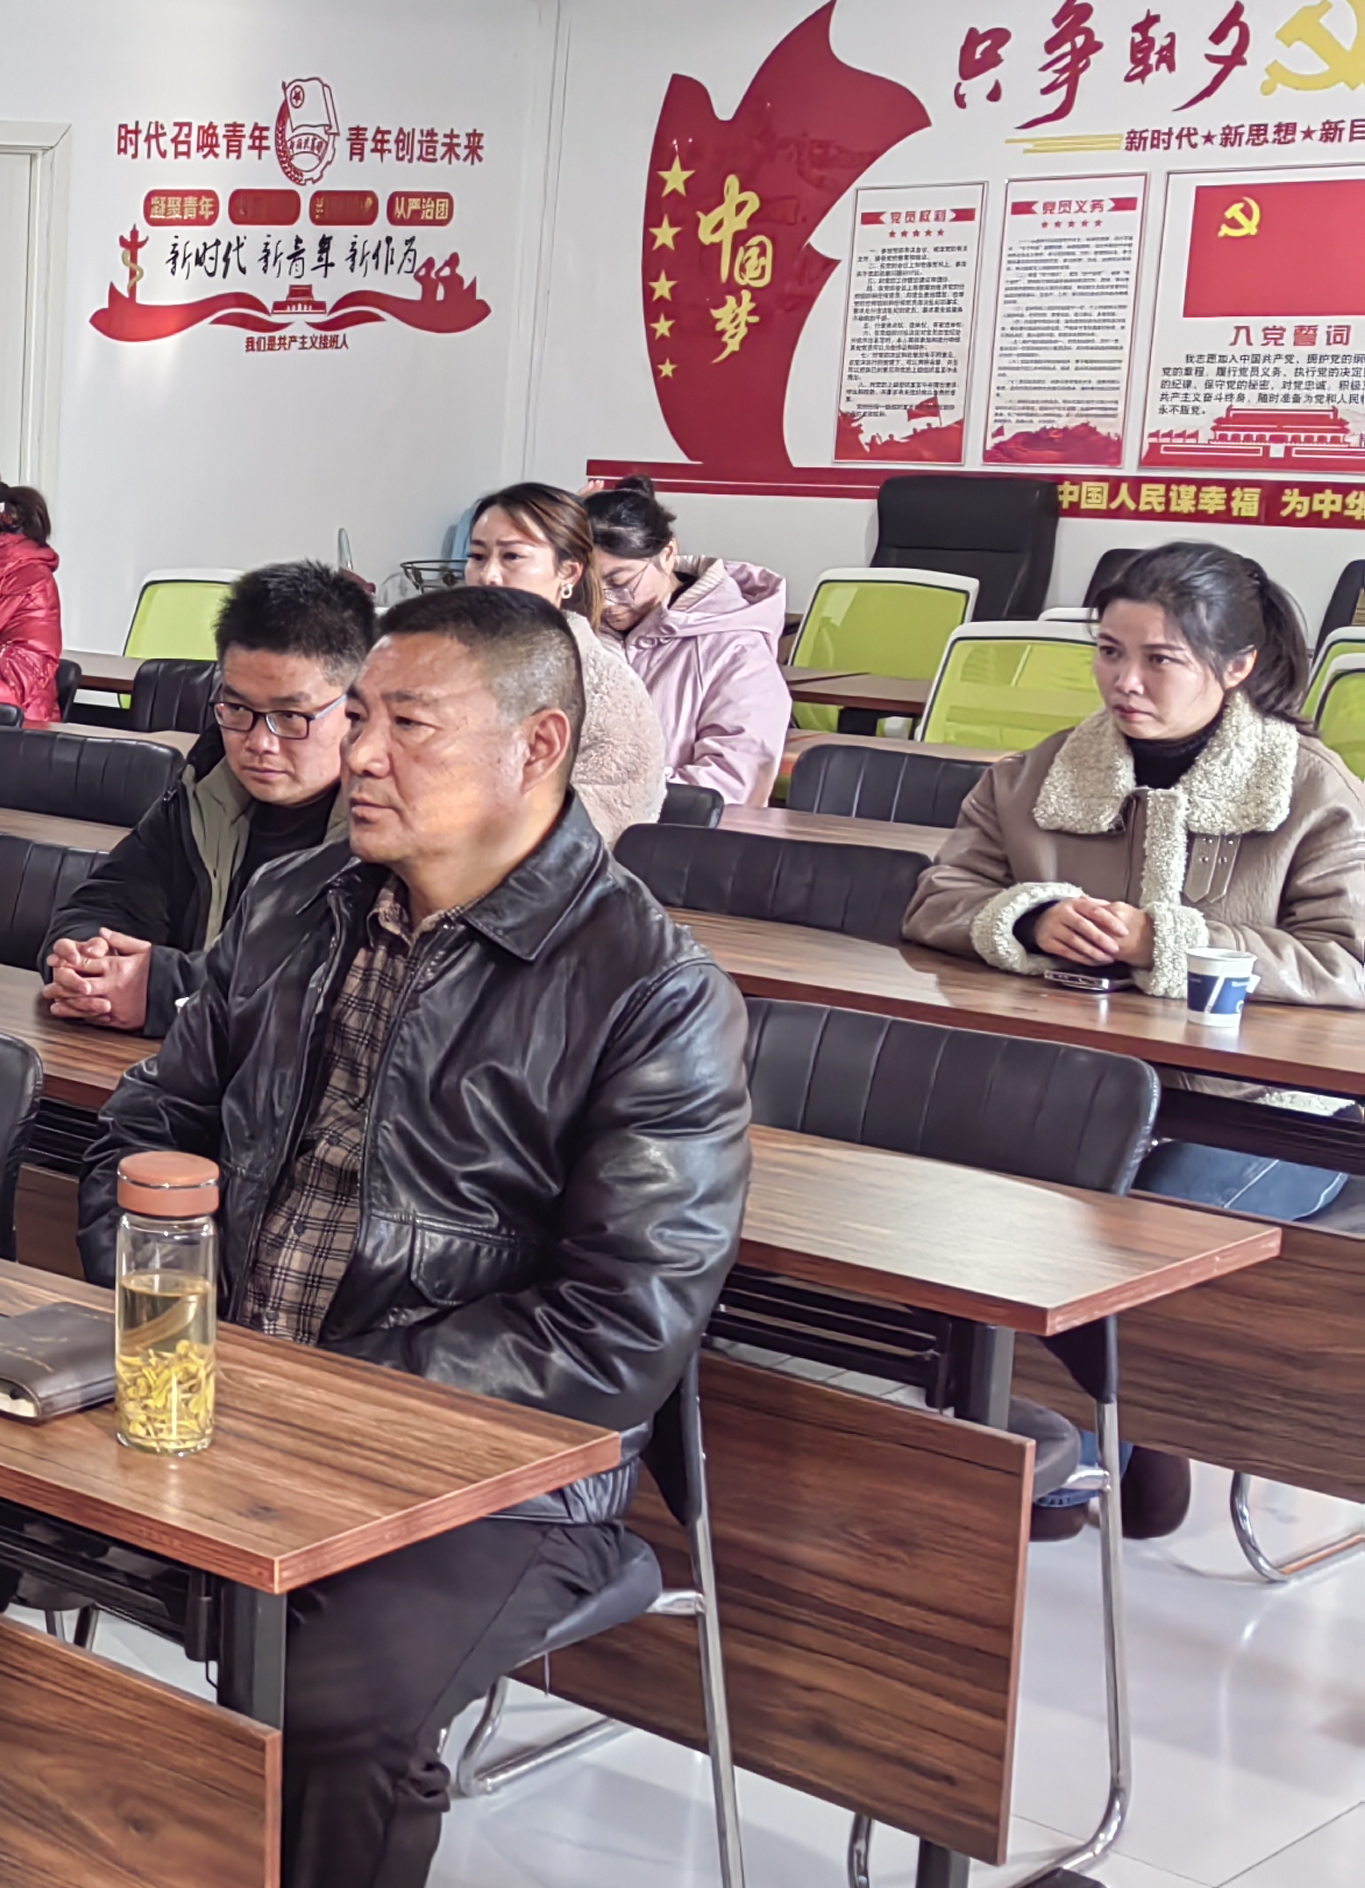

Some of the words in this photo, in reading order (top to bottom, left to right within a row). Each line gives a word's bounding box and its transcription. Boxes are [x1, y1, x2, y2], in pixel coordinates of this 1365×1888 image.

[954, 0, 1250, 130] 只争朝夕
[117, 121, 271, 160] 时代召唤青年
[346, 125, 485, 165] 青年创造未来
[149, 195, 214, 220] 凝聚青年
[394, 197, 449, 220] 从严治团
[165, 235, 247, 280] 新时代
[258, 233, 336, 280] 新青年
[344, 234, 418, 280] 新作为
[696, 174, 773, 364] 中国梦
[1229, 325, 1351, 347] 入党誓词
[1057, 480, 1262, 517] 中国人民谋幸福
